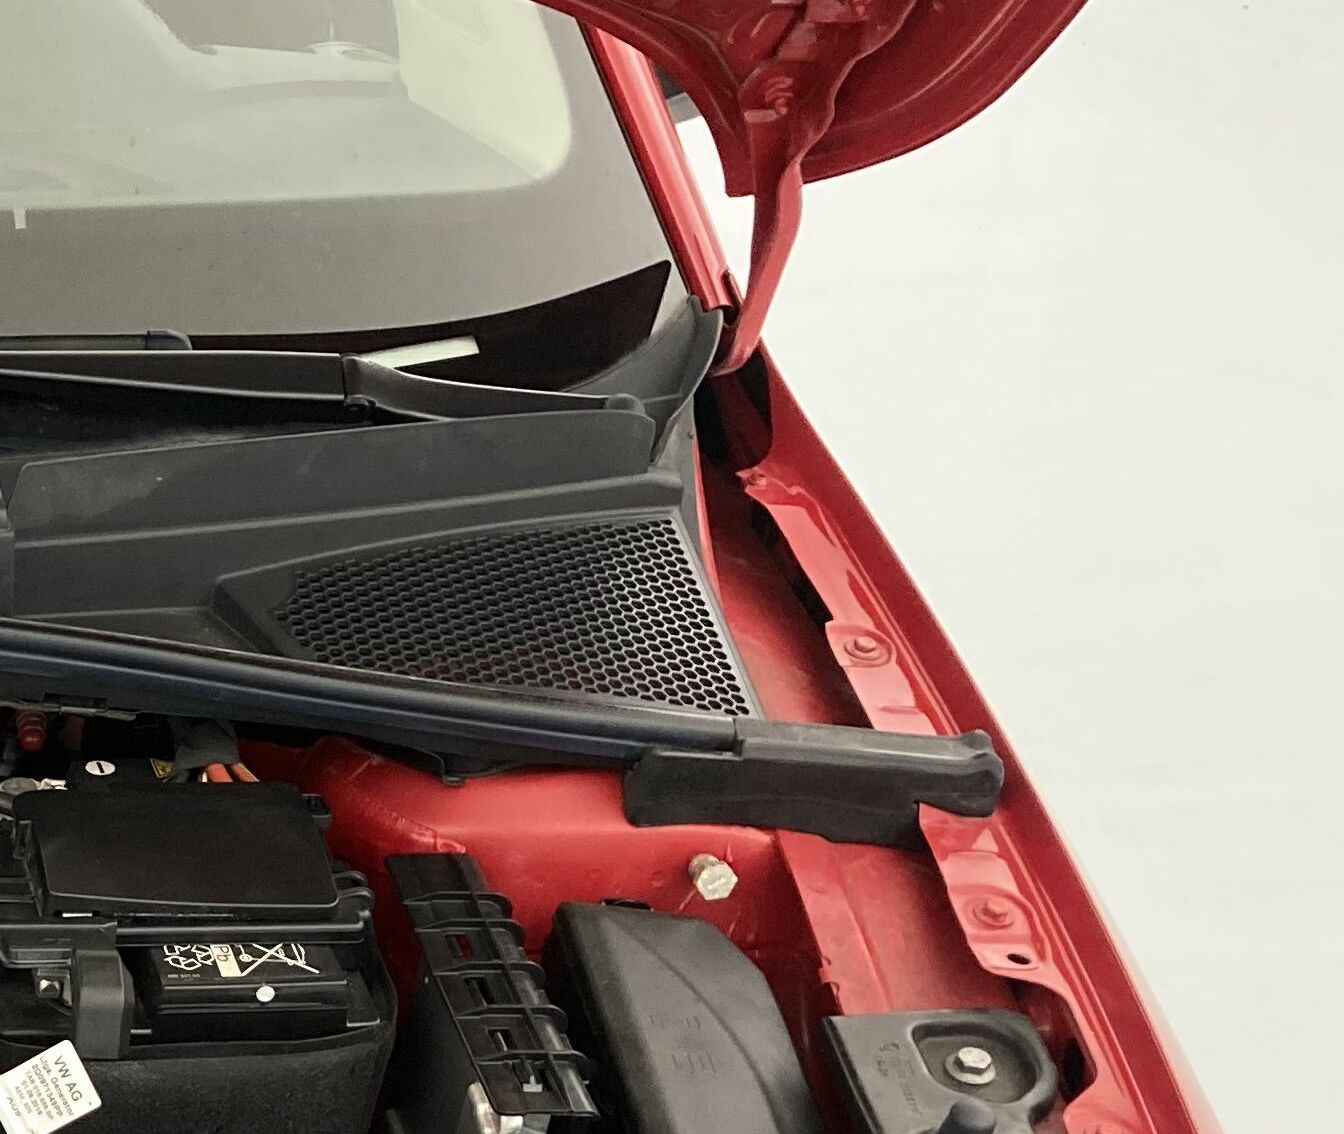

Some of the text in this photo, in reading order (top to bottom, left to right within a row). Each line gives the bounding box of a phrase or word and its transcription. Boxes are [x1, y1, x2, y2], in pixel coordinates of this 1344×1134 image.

[214, 945, 231, 962] Pb
[51, 1077, 75, 1116] Generator
[54, 1055, 83, 1102] VW AG
